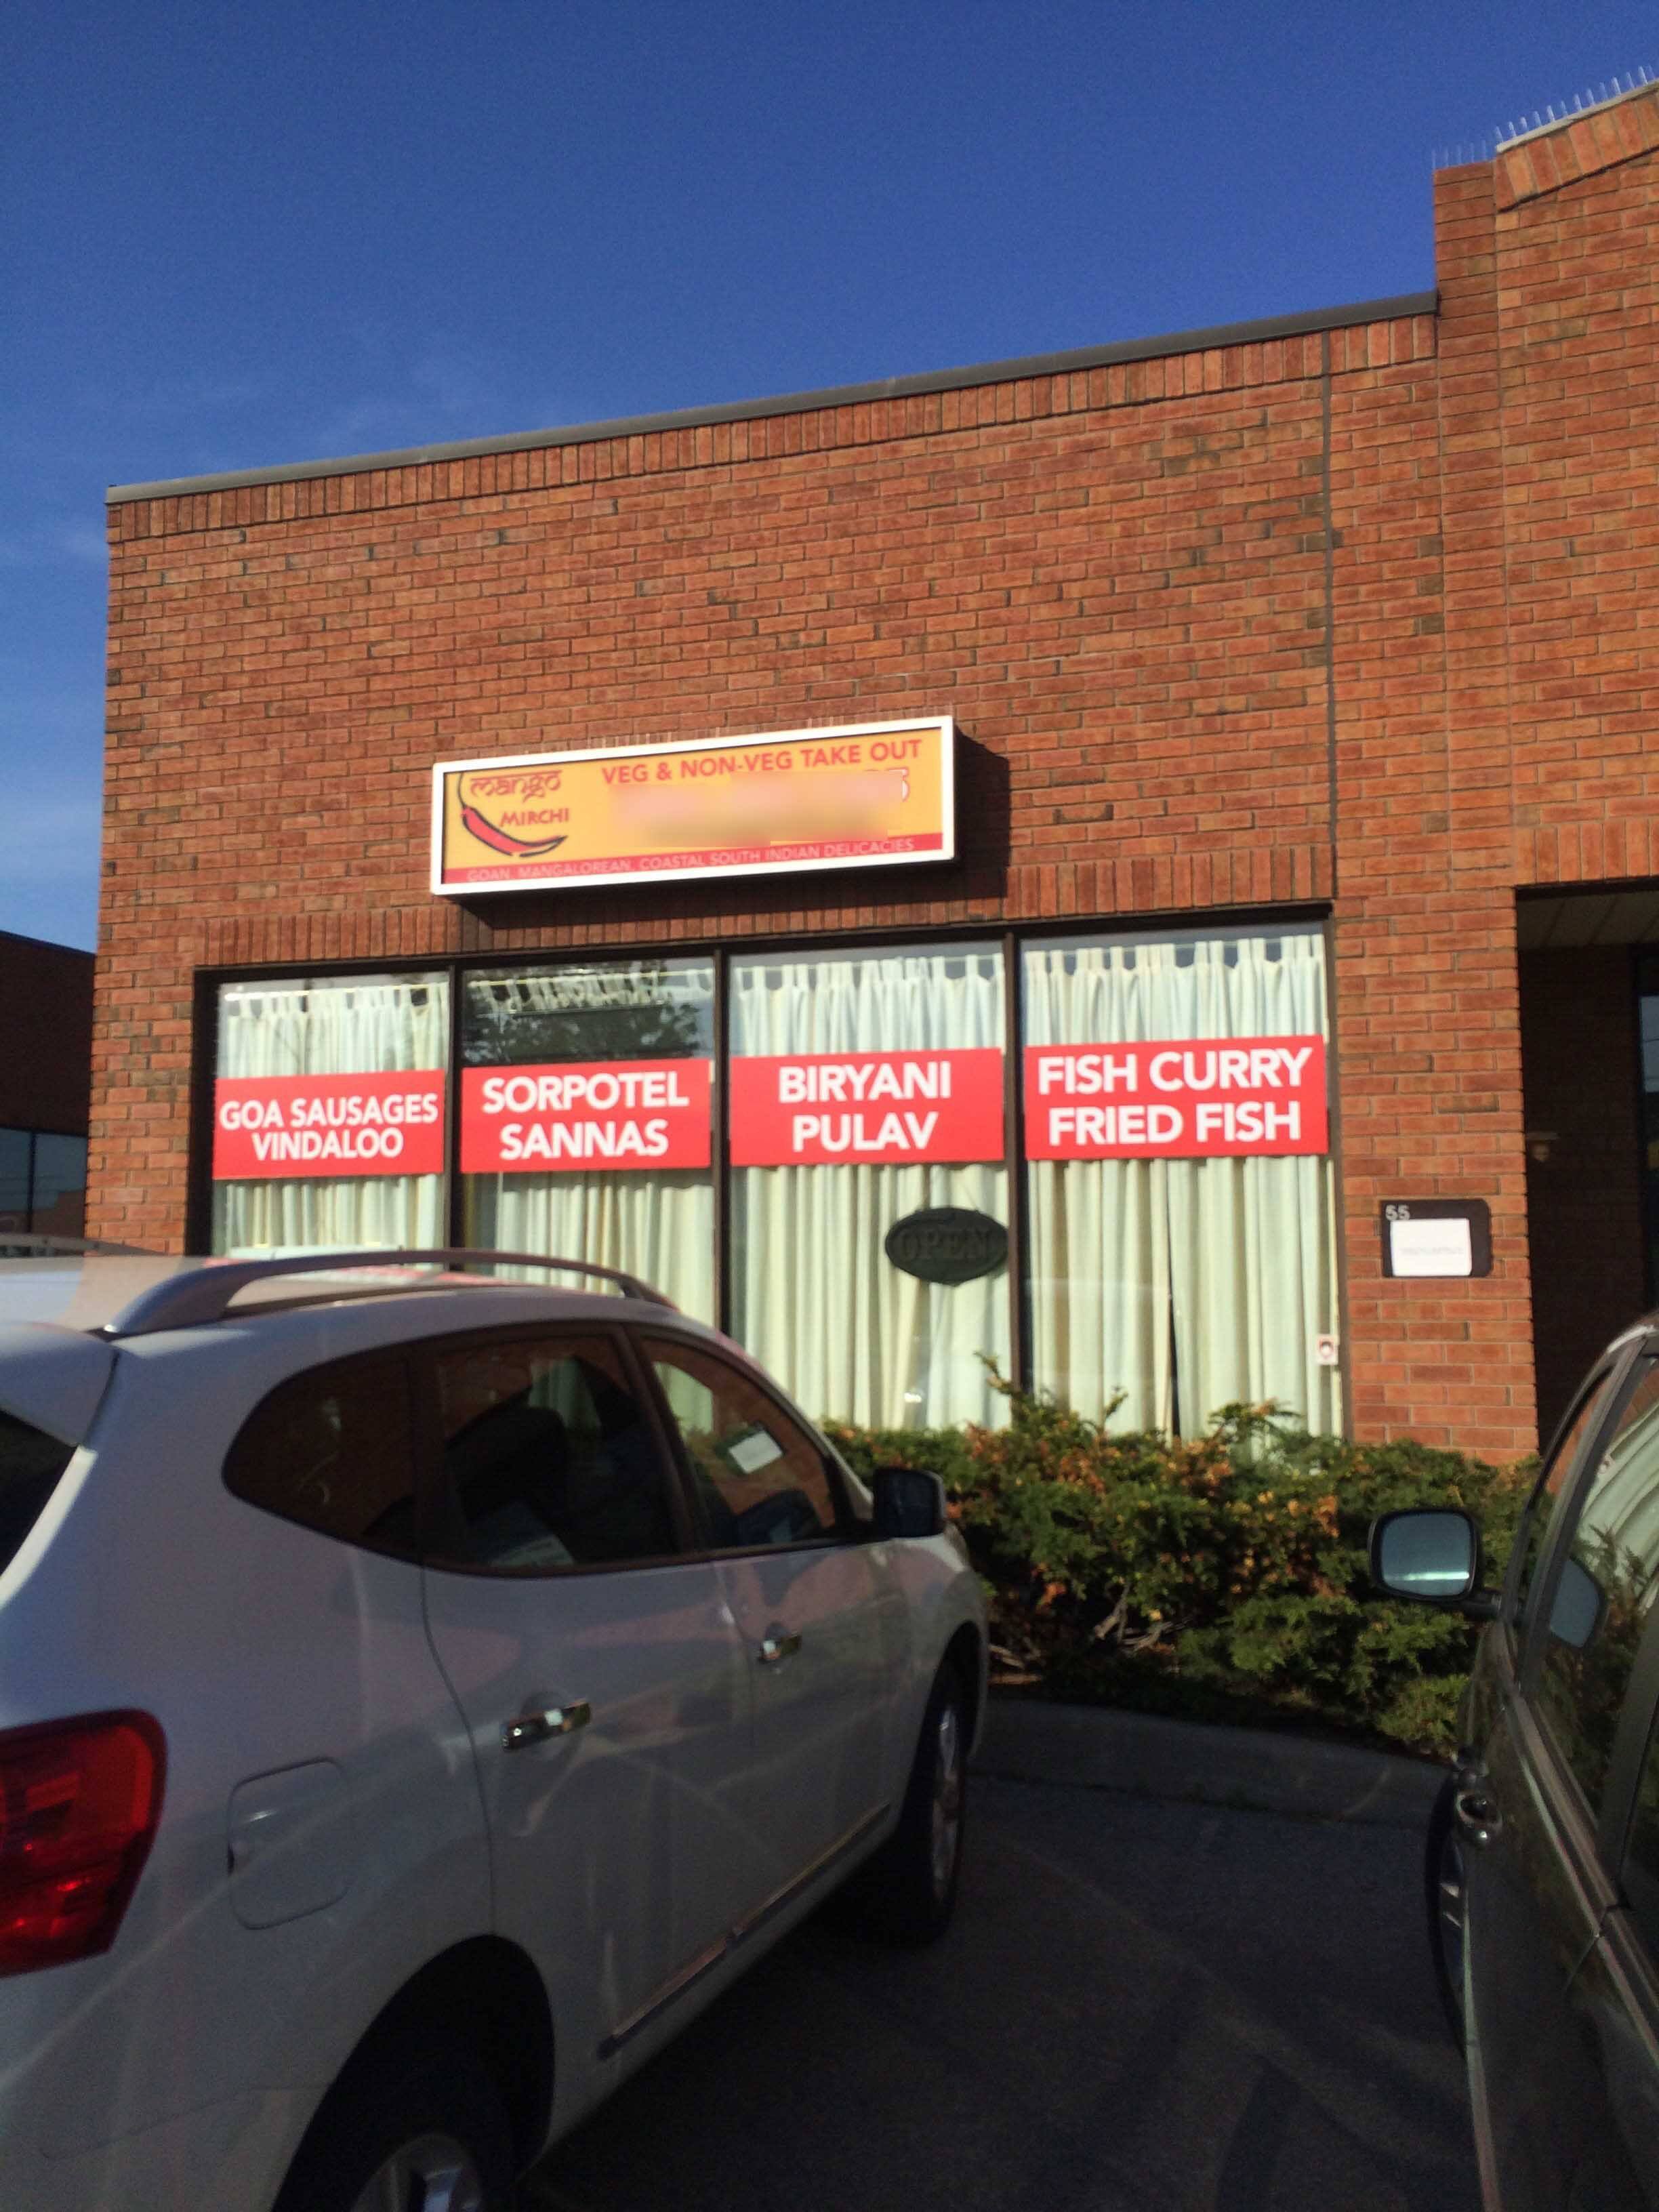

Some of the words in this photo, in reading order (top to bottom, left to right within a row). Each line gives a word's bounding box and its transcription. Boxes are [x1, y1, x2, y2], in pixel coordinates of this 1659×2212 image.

[602, 764, 648, 784] VEG
[657, 762, 672, 781] &
[680, 752, 792, 779] NON-VEG
[800, 745, 861, 767] TAKE
[870, 739, 922, 762] OUT
[499, 808, 569, 827] MIRCHI
[639, 856, 705, 870] COASTAL
[710, 851, 760, 865] SOUTH
[765, 846, 820, 861] INDIAN
[779, 1061, 951, 1103] BIRYANI
[1038, 1053, 1137, 1095] FISH
[1149, 1047, 1313, 1092] CURRY
[220, 1099, 284, 1130] GOA
[290, 1093, 439, 1128] SAUSAGES
[483, 1071, 690, 1113] SORPOTEL
[252, 1127, 404, 1161] VINDALOO
[499, 1119, 669, 1160] SANNAS
[793, 1111, 939, 1152] PULAV
[1049, 1104, 1185, 1146] FRIED
[1195, 1101, 1301, 1143] FISH
